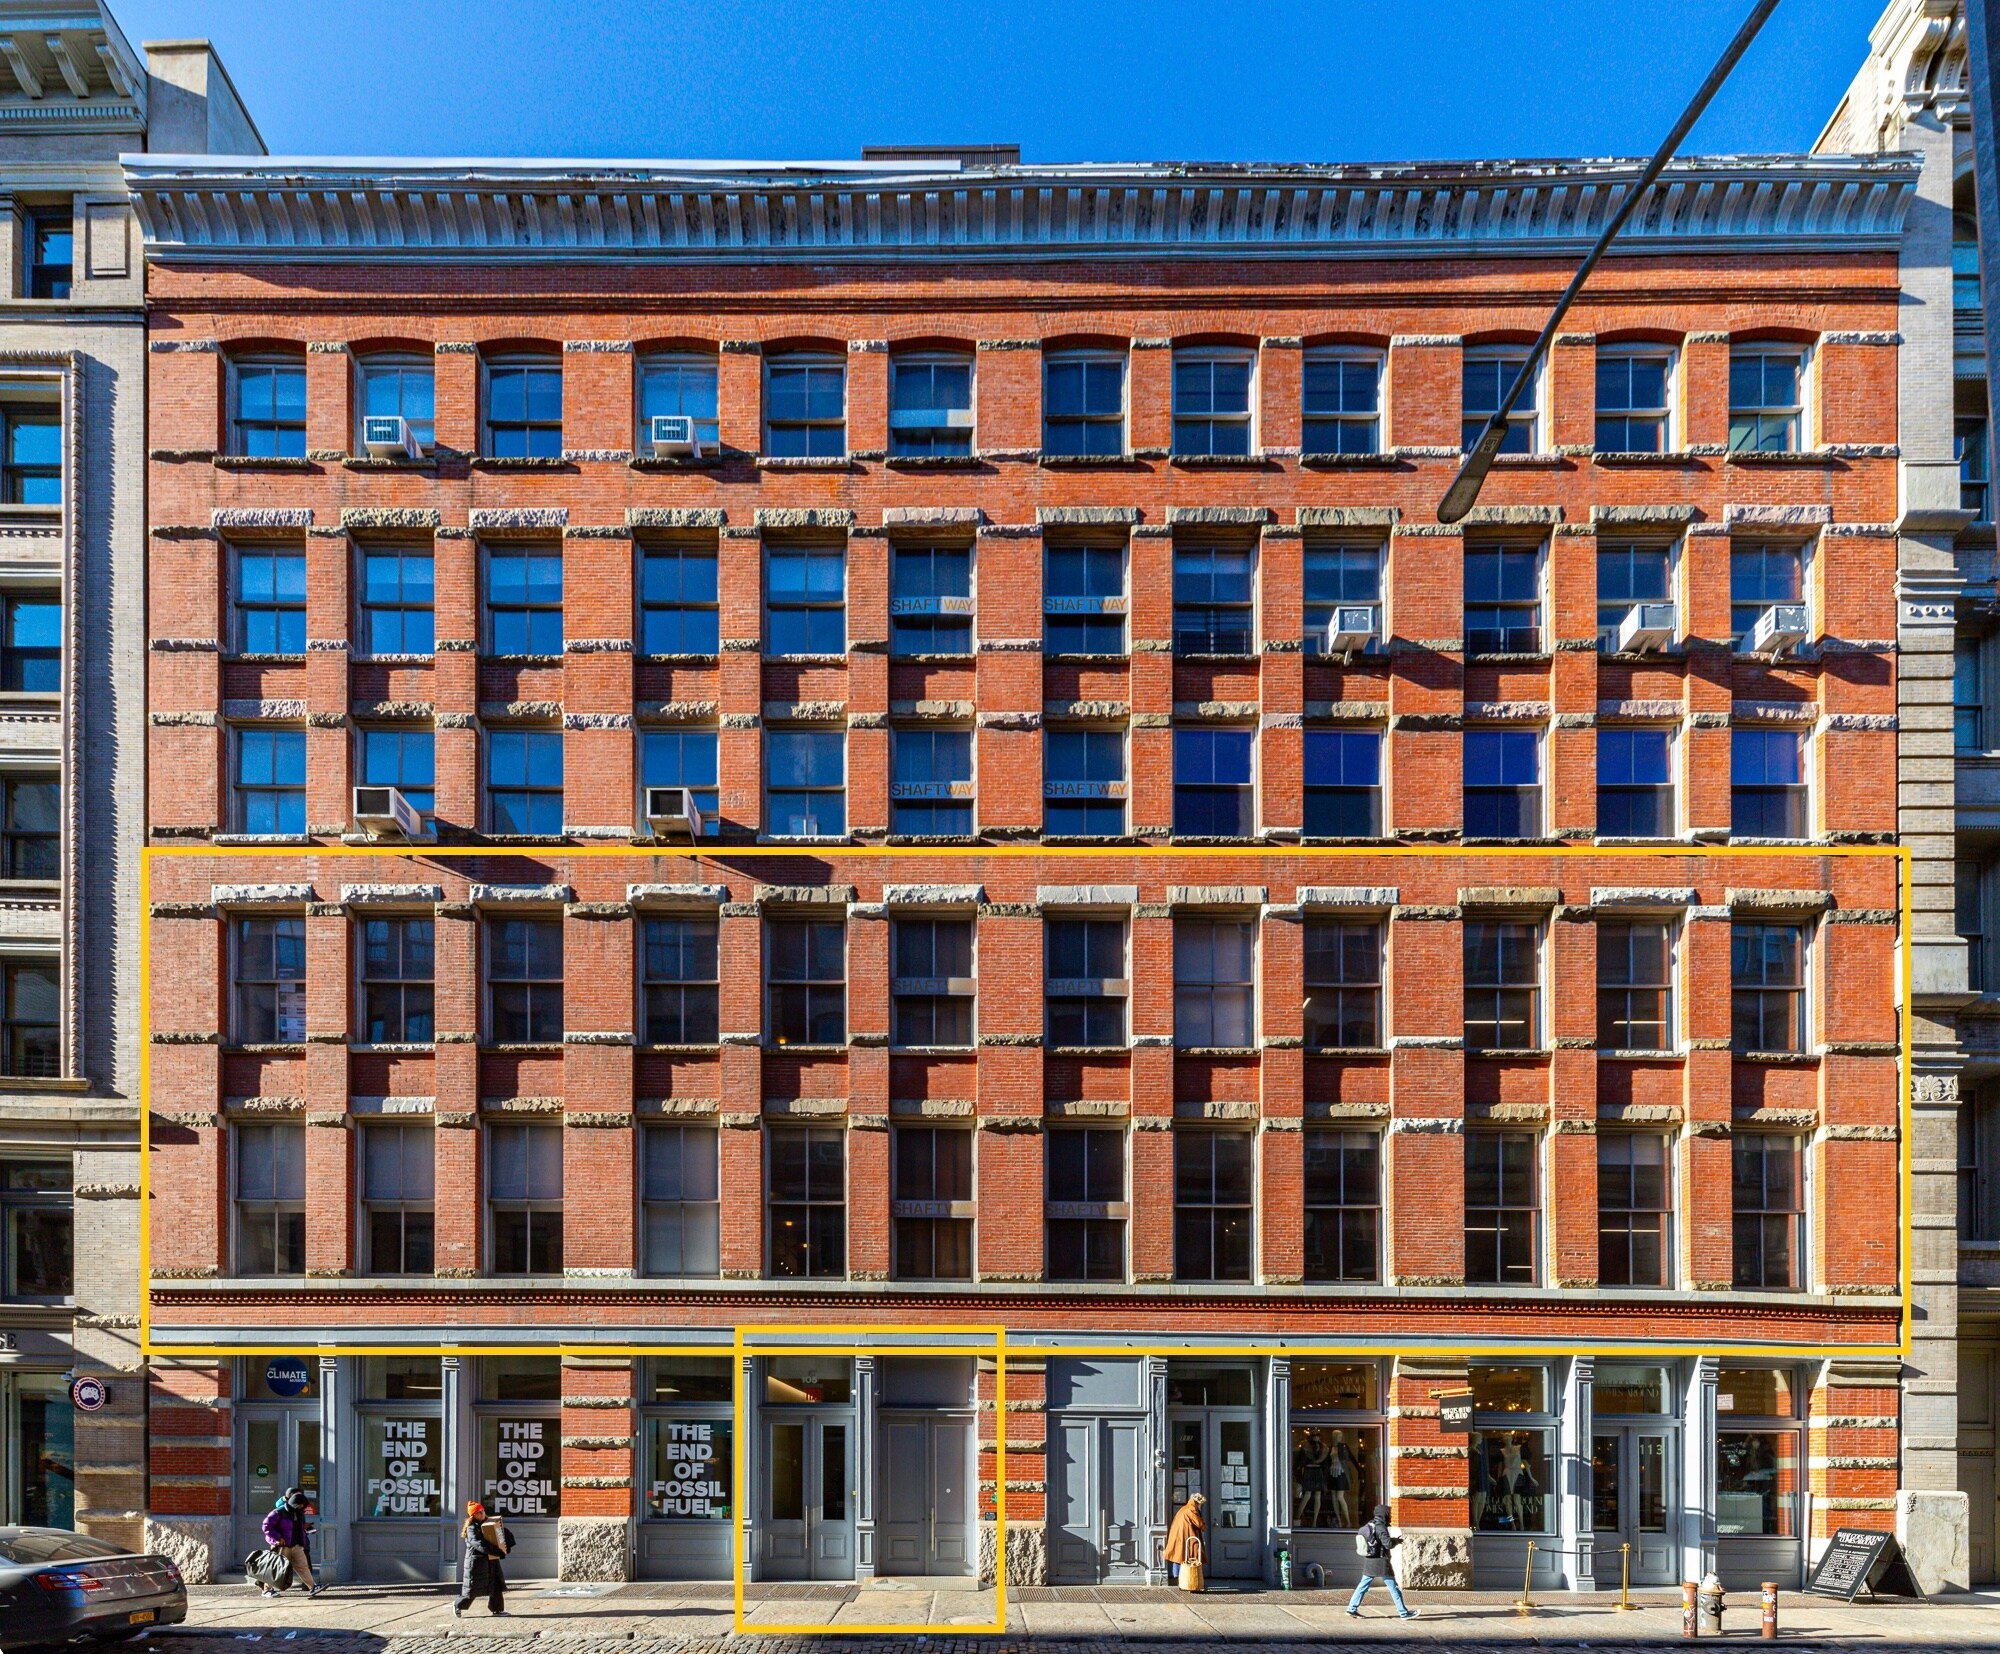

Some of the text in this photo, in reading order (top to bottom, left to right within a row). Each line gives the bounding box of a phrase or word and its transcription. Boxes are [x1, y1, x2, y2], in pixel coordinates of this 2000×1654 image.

[891, 599, 973, 612] SHAFTWAY
[1044, 598, 1127, 611] SHAFTWAY
[891, 783, 974, 796] SHAFTWAY
[1044, 783, 1127, 796] SHAFTWAY
[891, 980, 972, 993] SHAFT
[892, 1202, 973, 1214] SHAFTW
[1044, 1203, 1126, 1216] SHAFTW
[267, 1371, 307, 1379] CLIMATE
[383, 1422, 426, 1438] THE
[500, 1423, 542, 1439] THE
[668, 1424, 711, 1440] THE
[382, 1441, 427, 1458] END
[499, 1442, 544, 1459] END
[667, 1443, 712, 1460] END
[1640, 1444, 1663, 1455] 113
[389, 1460, 419, 1477] OF
[505, 1461, 536, 1478] OF
[674, 1462, 704, 1479] OF
[368, 1478, 440, 1495] FOSSIL
[485, 1479, 557, 1496] FOSSIL
[653, 1480, 726, 1497] FOSSIL
[378, 1496, 430, 1512] FUEL
[494, 1497, 547, 1513] FUEL
[662, 1498, 715, 1515] FUEL
